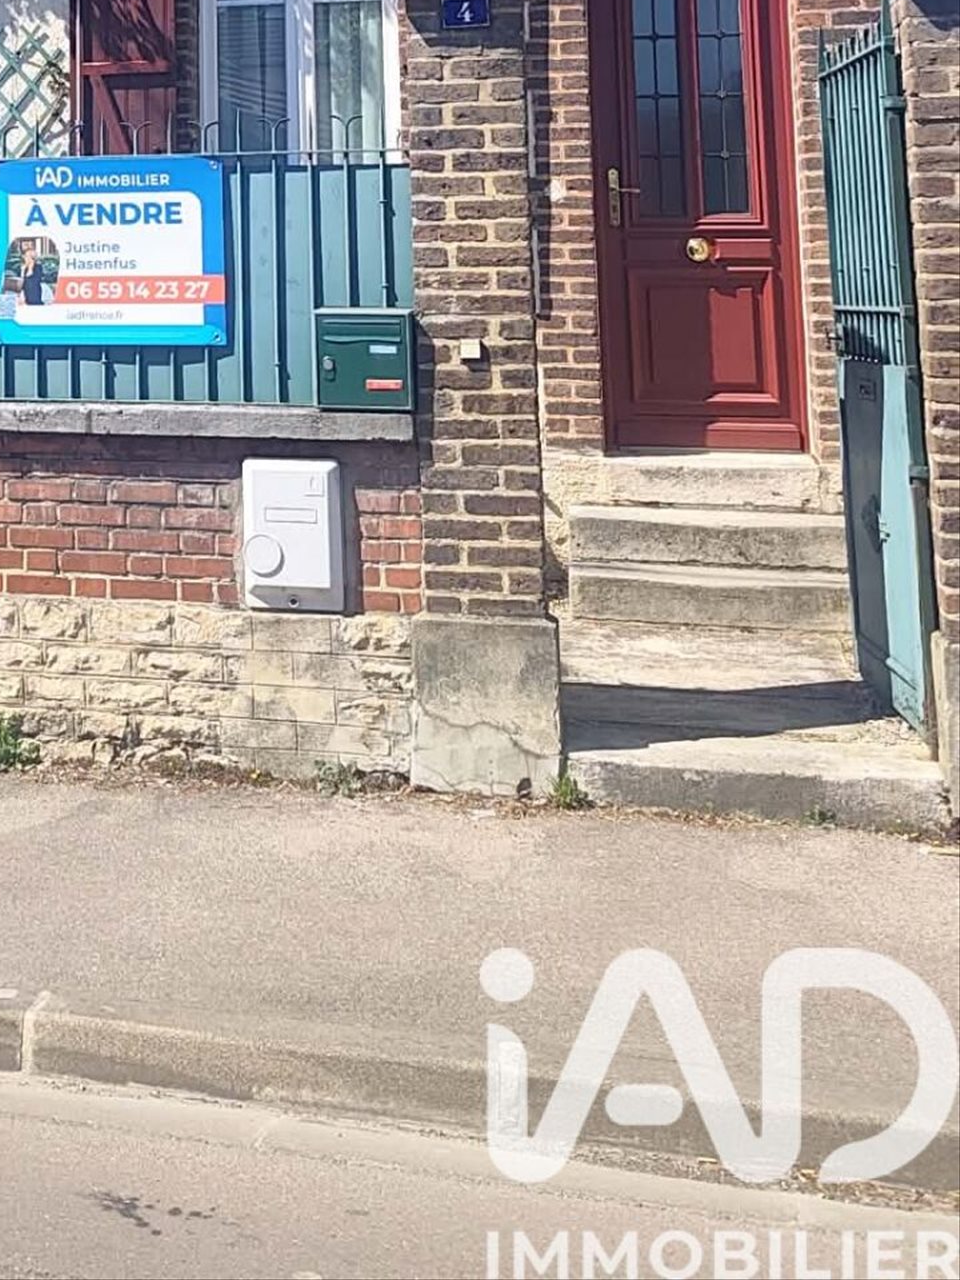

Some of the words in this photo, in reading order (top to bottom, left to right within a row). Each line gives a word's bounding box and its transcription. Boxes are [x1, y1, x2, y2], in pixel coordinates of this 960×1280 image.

[457, 1, 474, 22] 4
[78, 173, 170, 187] IMMOBILIER
[25, 198, 48, 227] À
[55, 201, 183, 226] VENDRE
[64, 240, 121, 254] Justine
[65, 256, 138, 271] Hasenfus
[65, 282, 93, 299] 06
[97, 282, 123, 299] 59
[128, 282, 150, 299] 14
[154, 281, 179, 299] 23
[184, 281, 210, 299] 27
